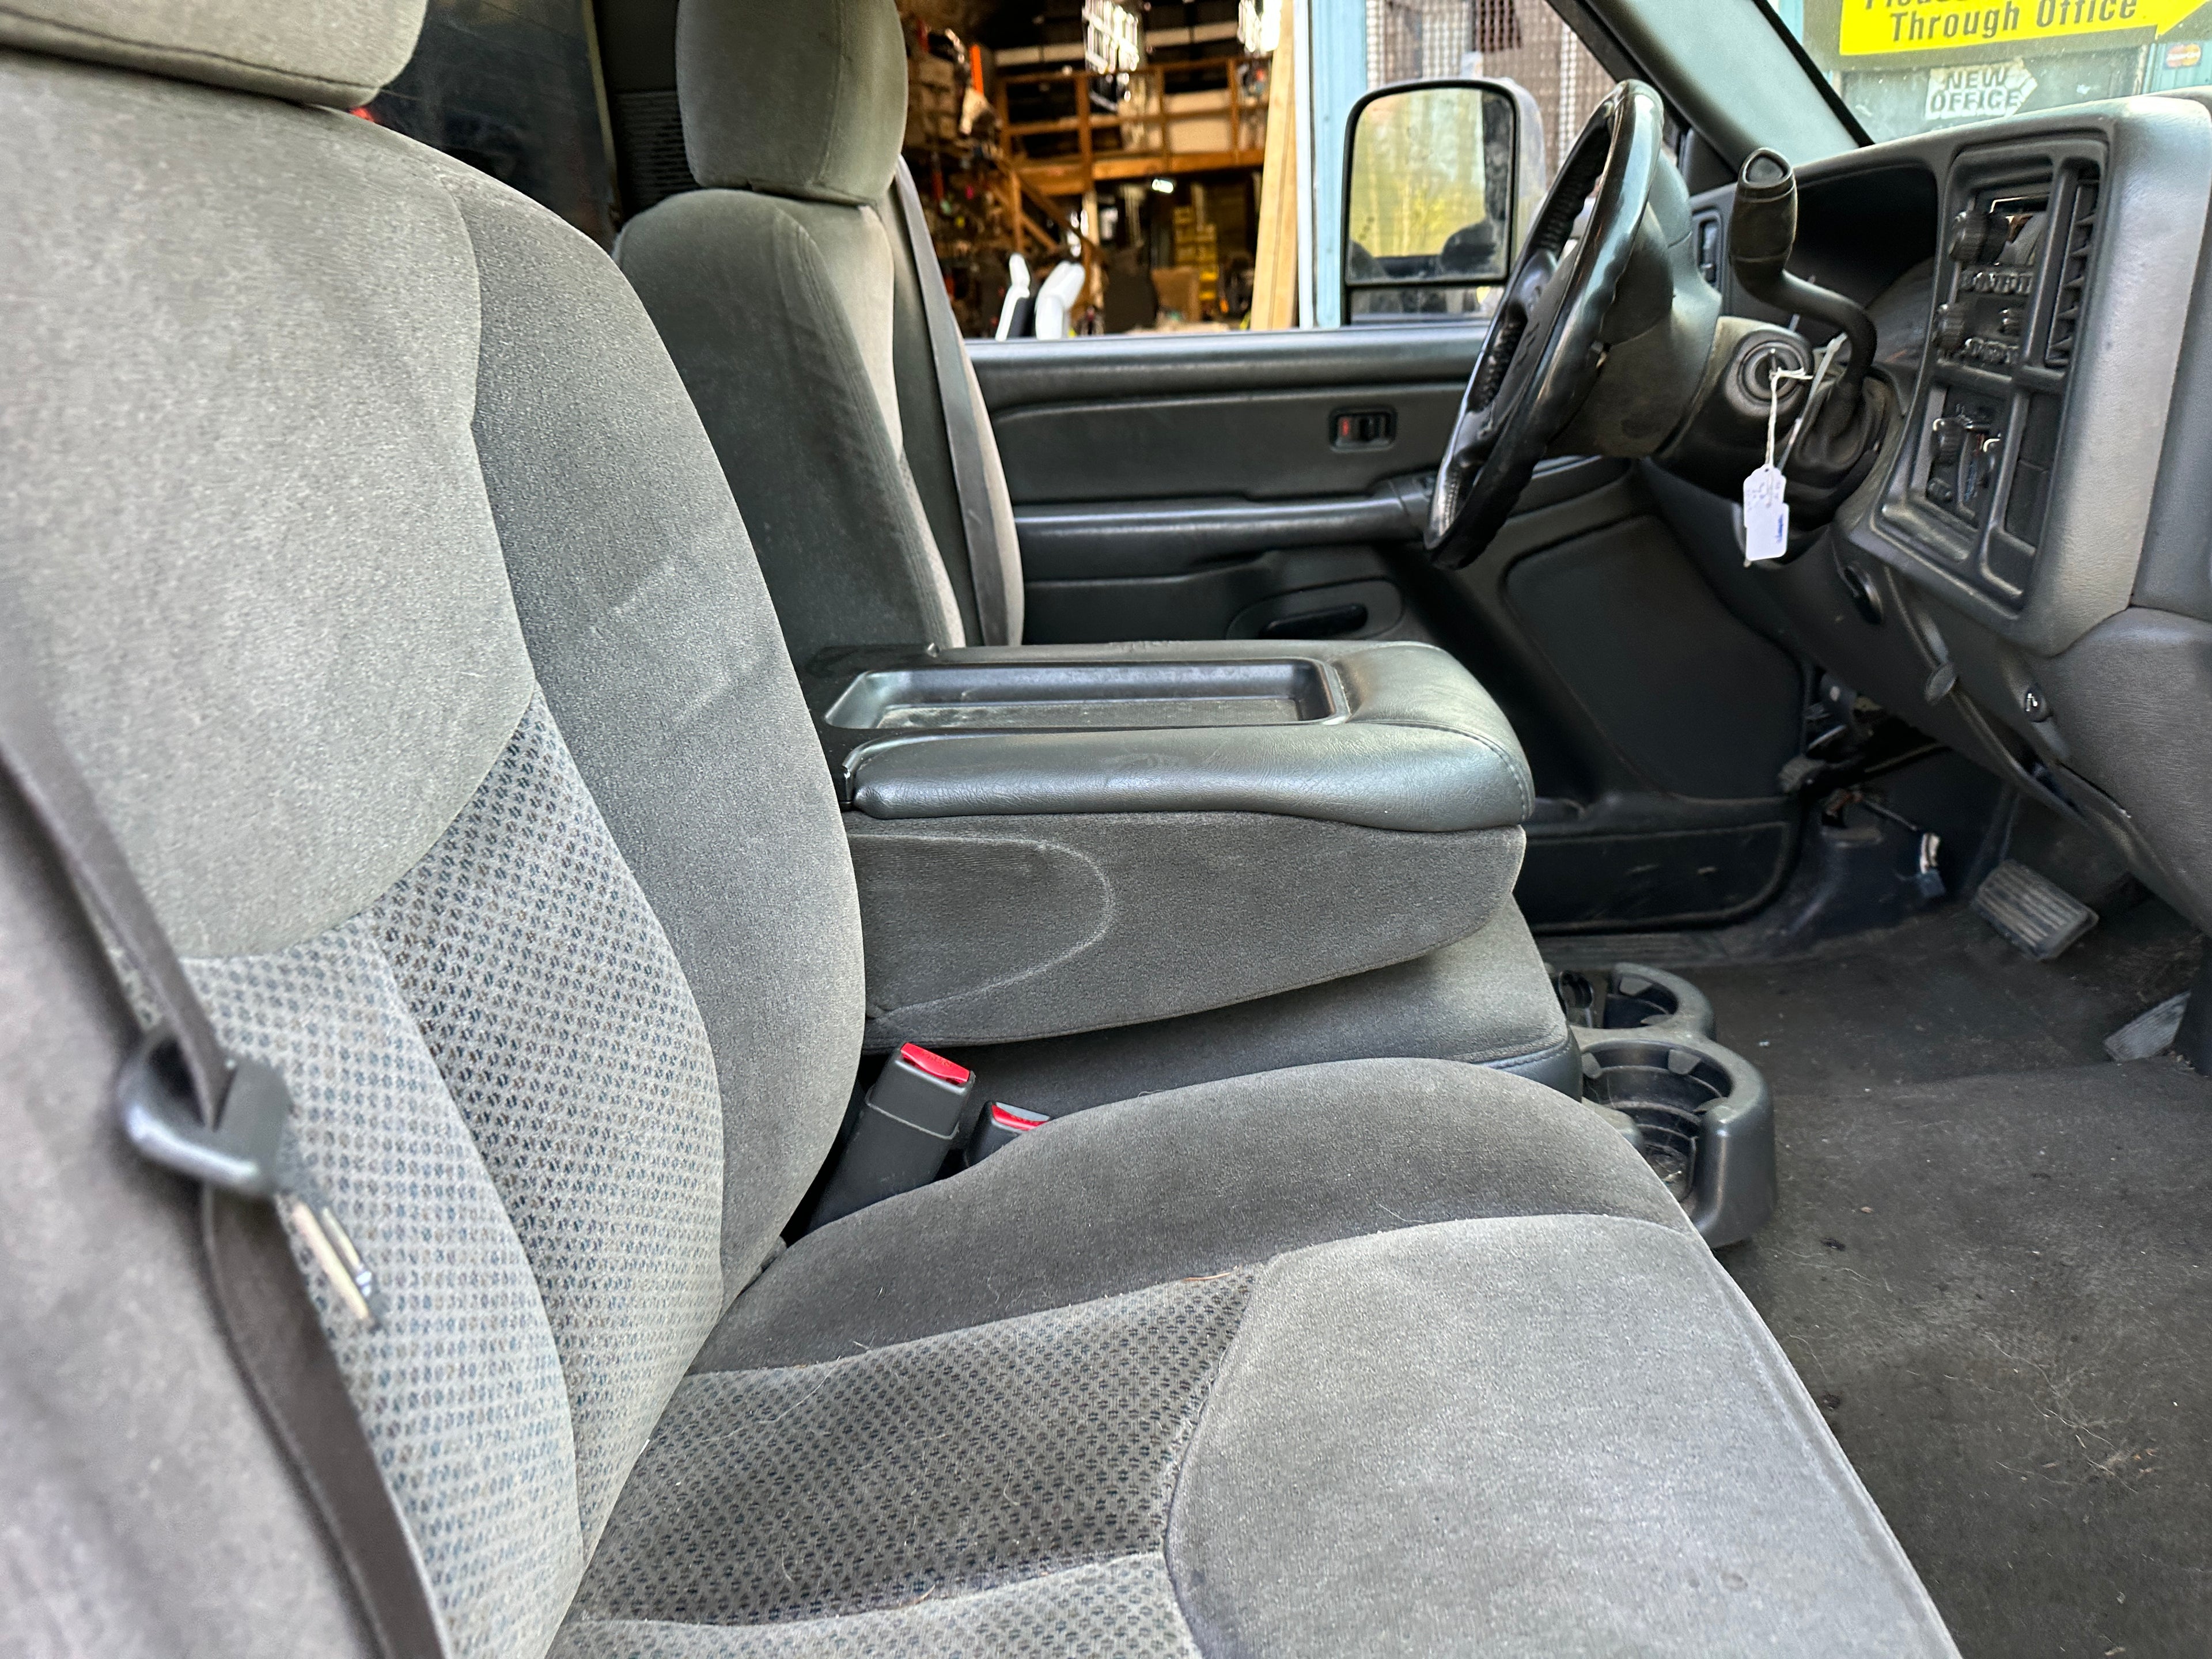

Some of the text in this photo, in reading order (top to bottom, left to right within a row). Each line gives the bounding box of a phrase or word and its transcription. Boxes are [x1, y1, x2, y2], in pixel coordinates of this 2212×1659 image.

[1890, 0, 2136, 41] Through Office
[1946, 69, 2005, 89] NEW
[1930, 88, 2021, 112] OFFICE
